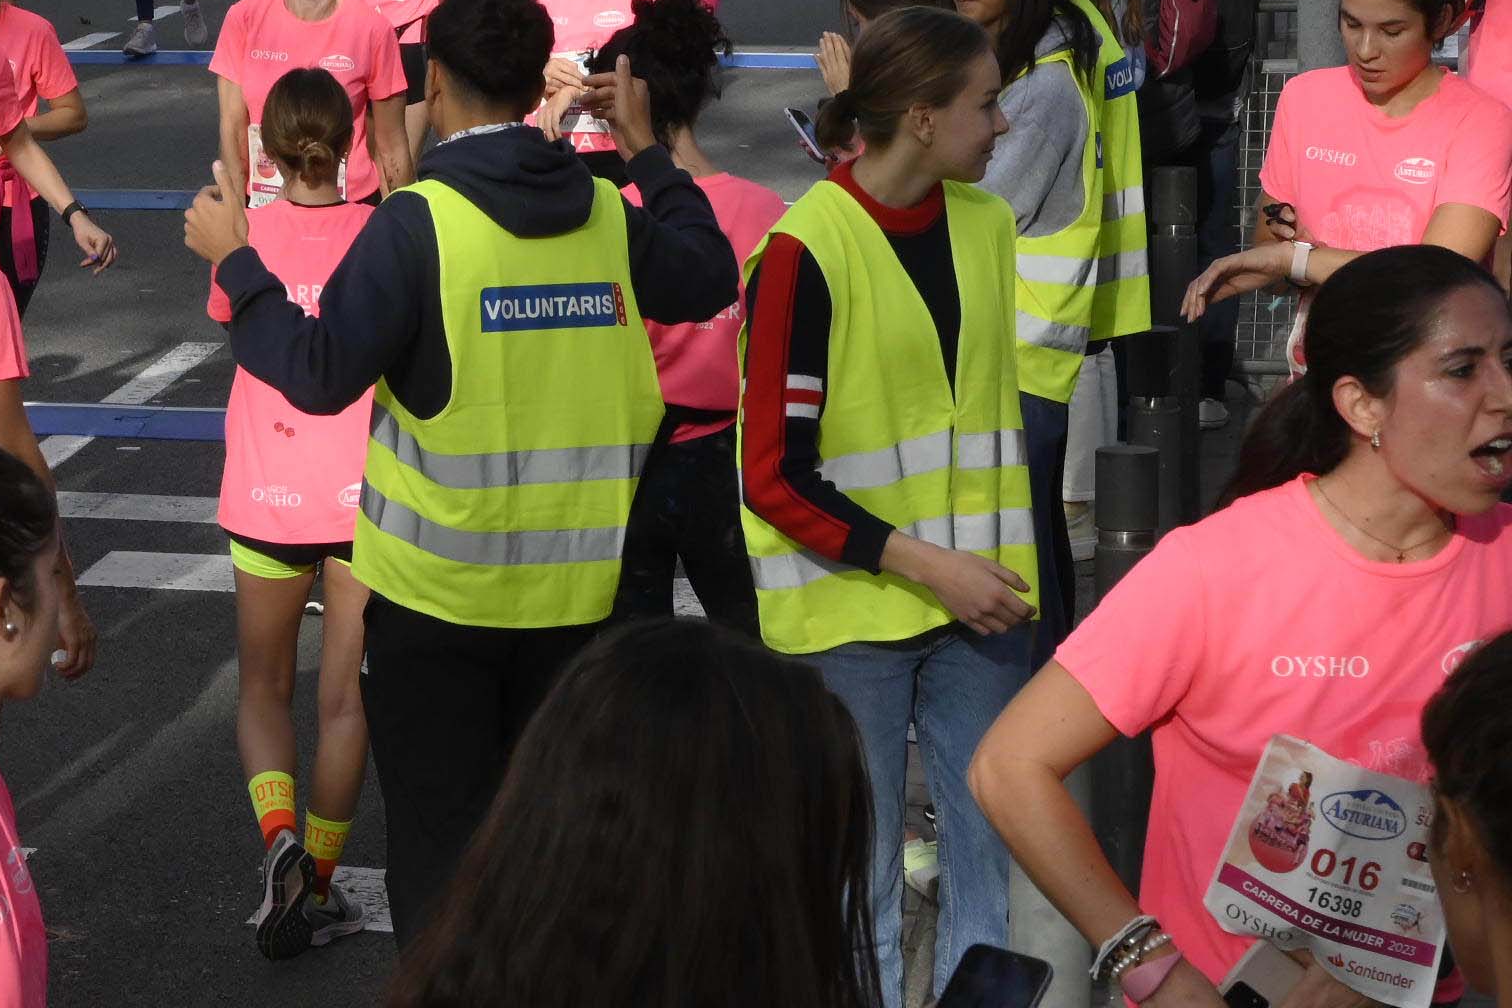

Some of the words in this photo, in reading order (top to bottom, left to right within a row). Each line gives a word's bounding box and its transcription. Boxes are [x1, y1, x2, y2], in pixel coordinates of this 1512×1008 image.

[251, 48, 289, 62] OYSHO
[1305, 146, 1358, 167] OYSHO
[484, 293, 613, 321] VOLUNTARIS
[1271, 655, 1370, 678] OYSHO
[1324, 800, 1401, 835] ASTURIANA
[1310, 848, 1382, 891] 016
[1307, 885, 1363, 919] 16398
[1225, 903, 1294, 942] OYSHO
[1242, 880, 1299, 919] CARRERA
[1301, 912, 1321, 928] DE
[1324, 921, 1342, 935] LA
[1343, 926, 1385, 949] MUJER
[1387, 939, 1417, 957] 2023
[1346, 959, 1415, 990] Santander
